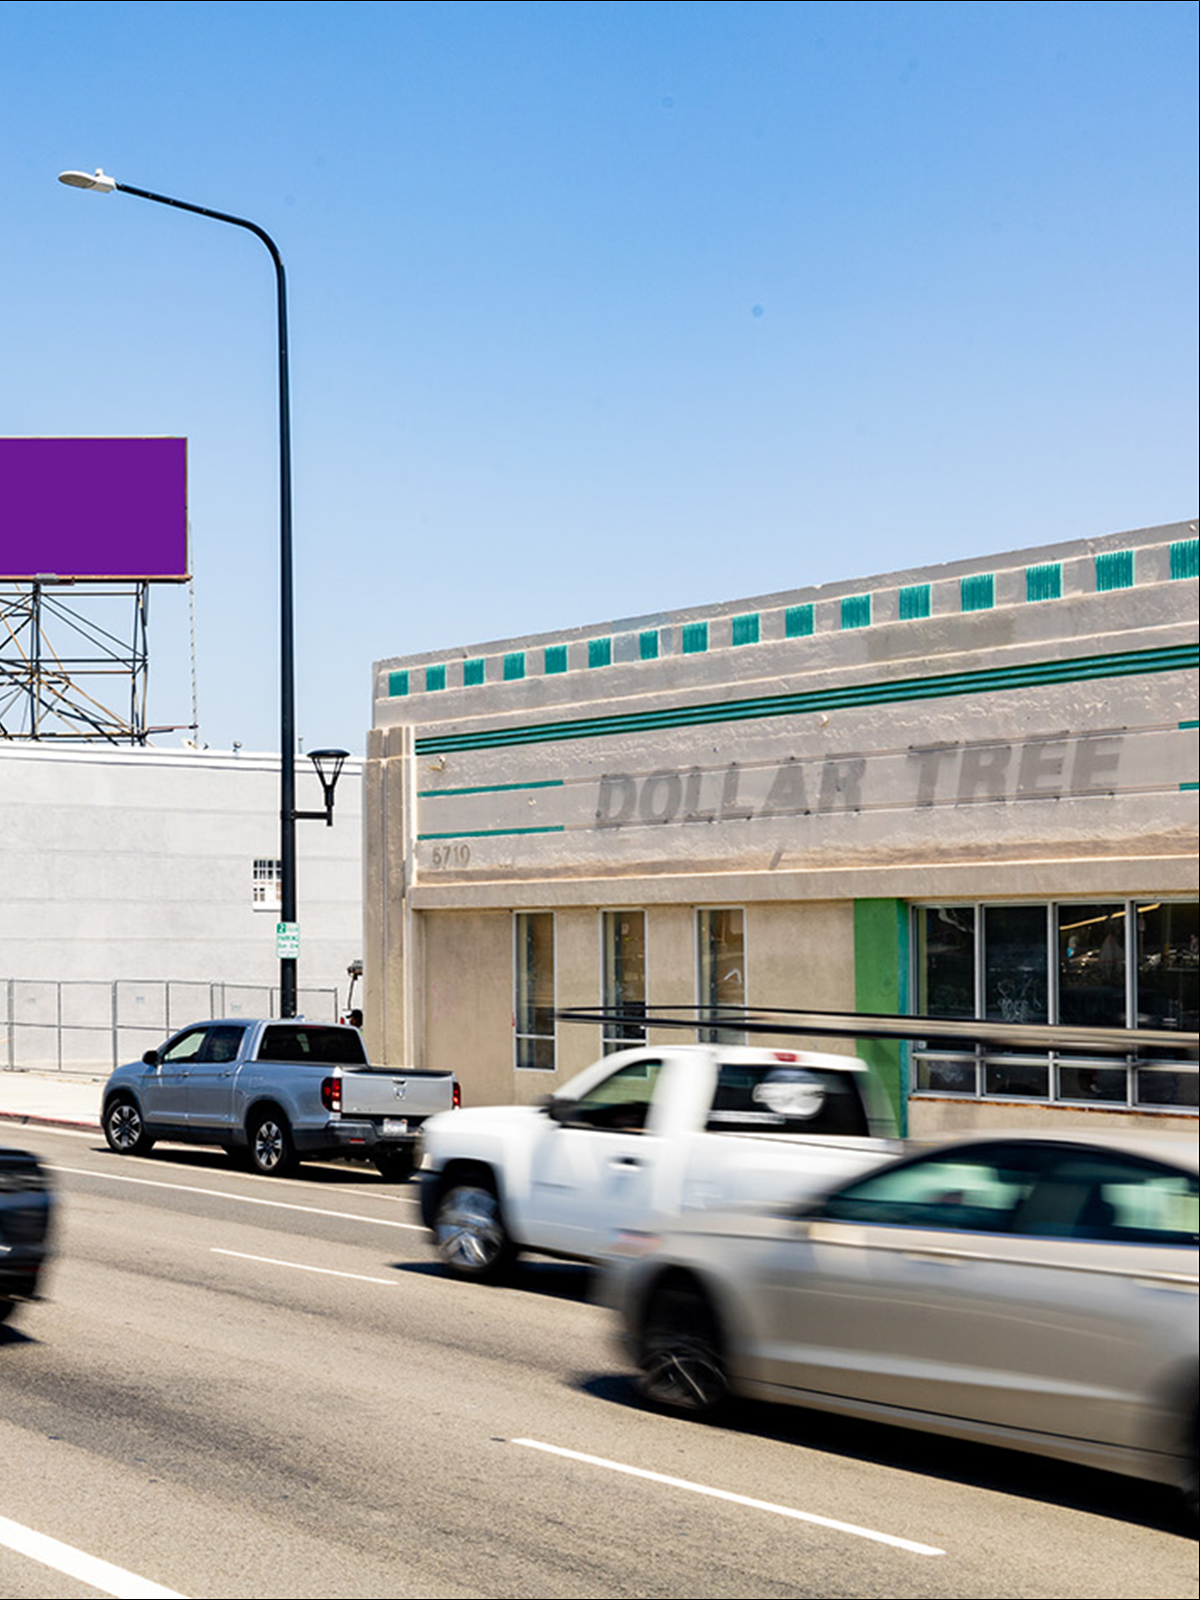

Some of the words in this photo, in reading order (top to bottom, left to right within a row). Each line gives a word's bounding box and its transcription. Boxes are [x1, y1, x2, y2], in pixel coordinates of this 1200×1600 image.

[596, 755, 867, 829] DOLLAR
[906, 732, 1123, 810] TREE
[432, 844, 471, 867] 5710
